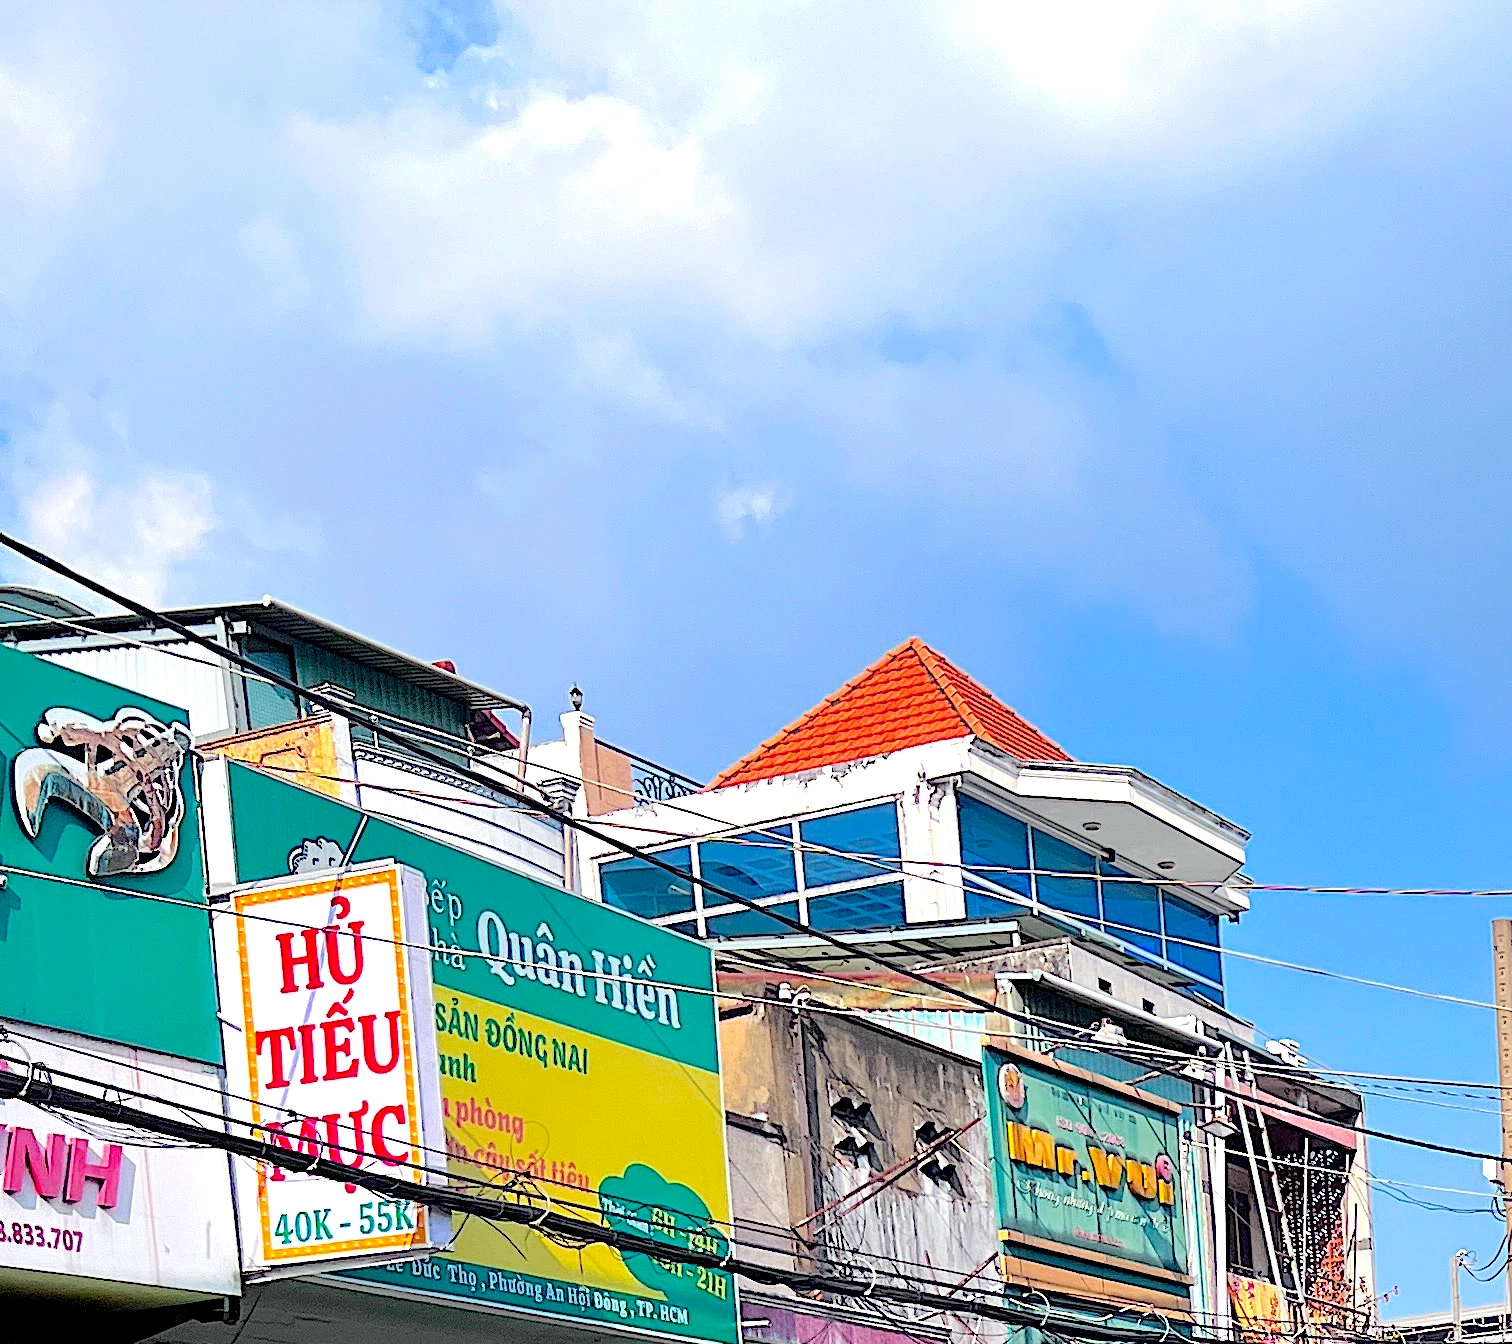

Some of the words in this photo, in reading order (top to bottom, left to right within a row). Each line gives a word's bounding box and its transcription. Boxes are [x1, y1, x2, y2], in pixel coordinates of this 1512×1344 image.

[426, 878, 463, 926] ếp
[276, 895, 366, 994] HỦ
[432, 926, 466, 971] hà
[477, 909, 587, 998] Quân
[591, 948, 682, 1030] Hiền
[256, 987, 401, 1090] TIẾU
[435, 997, 479, 1043] SẢN
[485, 1012, 548, 1068] ĐỒNG
[552, 1038, 589, 1075] NAI
[264, 1099, 411, 1195] MỰC
[455, 1096, 525, 1145] phòng
[0, 1124, 124, 1210] NH
[274, 1208, 334, 1245] 40K
[359, 1200, 415, 1236] 55K
[488, 1268, 544, 1302] Phường
[546, 1281, 565, 1302] An
[567, 1284, 591, 1312] Hội
[659, 1303, 689, 1326] HCM
[697, 1265, 728, 1301] 21H
